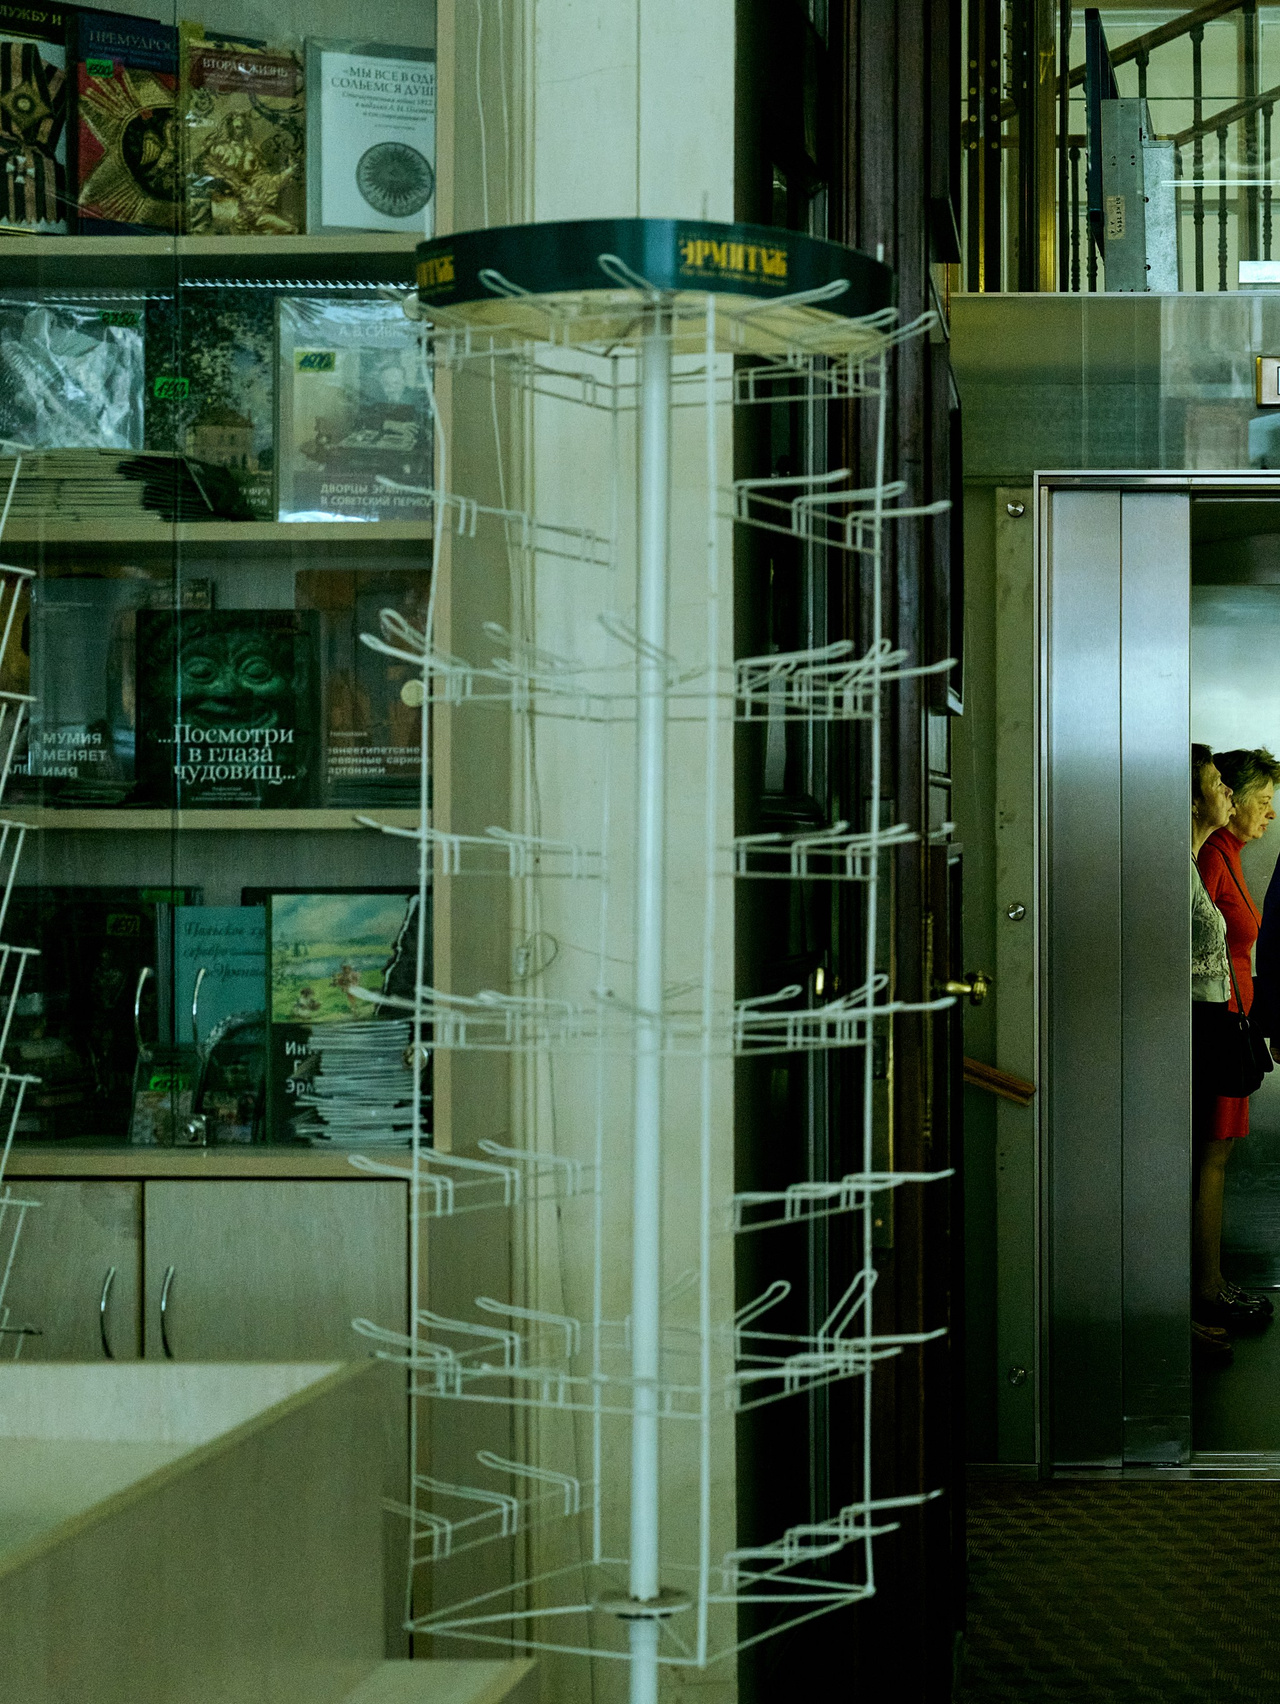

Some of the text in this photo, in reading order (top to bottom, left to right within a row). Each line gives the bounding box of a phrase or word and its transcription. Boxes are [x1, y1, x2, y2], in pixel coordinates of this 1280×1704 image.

[52, 14, 62, 26] И
[375, 69, 398, 81] ВСЕ
[401, 71, 408, 82] В
[331, 77, 402, 93] СОЛЬЕМСЯ
[320, 483, 368, 495] ДВОРЦЫ
[42, 732, 102, 745] МУМИЯ
[42, 749, 107, 762] МЕНЯЕТ
[188, 747, 274, 763] в глаза
[42, 766, 79, 778] ИМЯ
